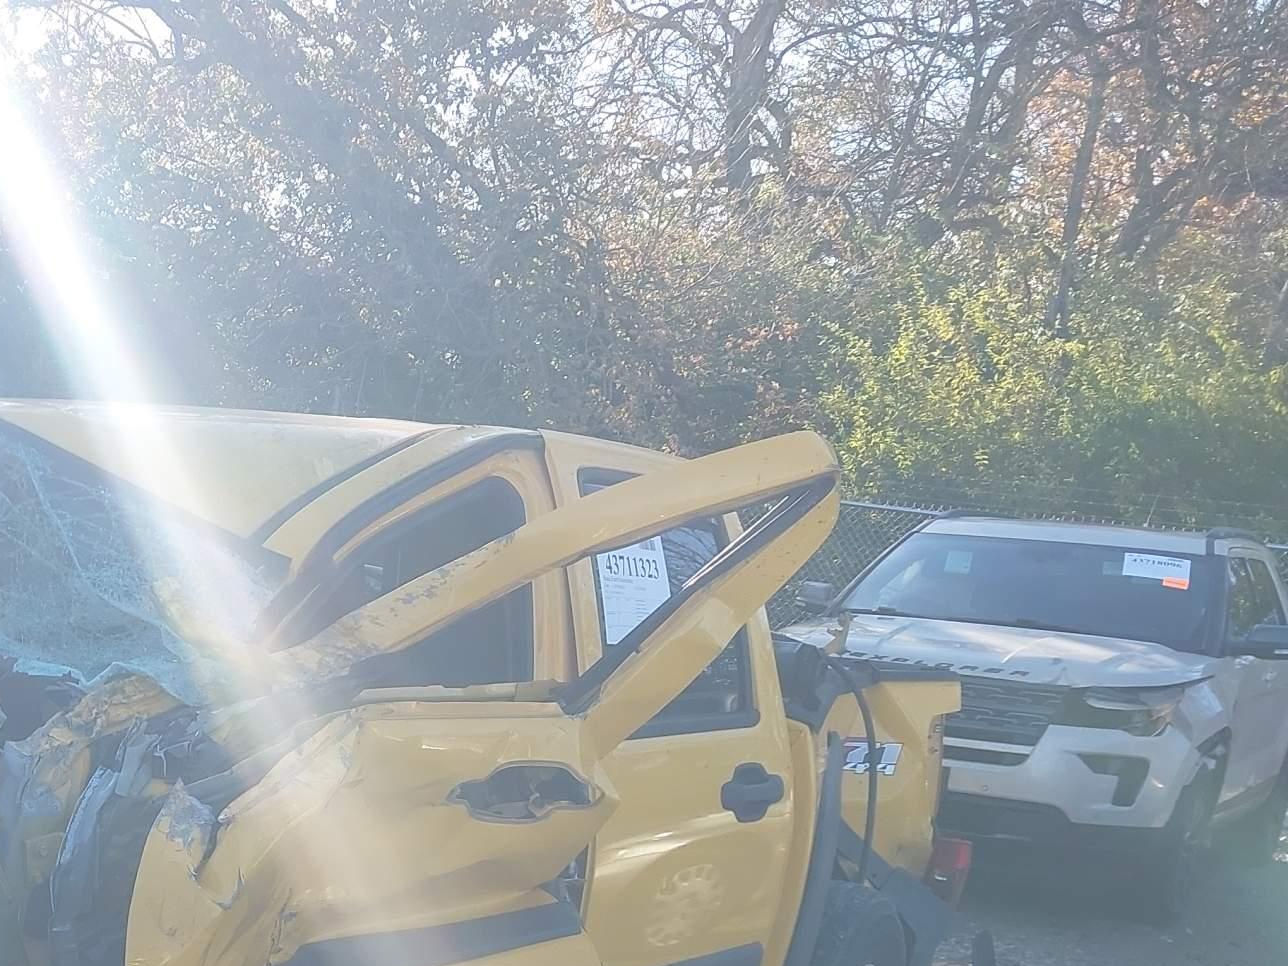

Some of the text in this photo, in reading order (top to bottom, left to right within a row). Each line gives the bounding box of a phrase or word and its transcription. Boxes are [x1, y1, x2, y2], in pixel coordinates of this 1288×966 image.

[605, 552, 660, 580] 43711323
[844, 650, 1031, 678] EXPLORER
[842, 760, 895, 776] 44
